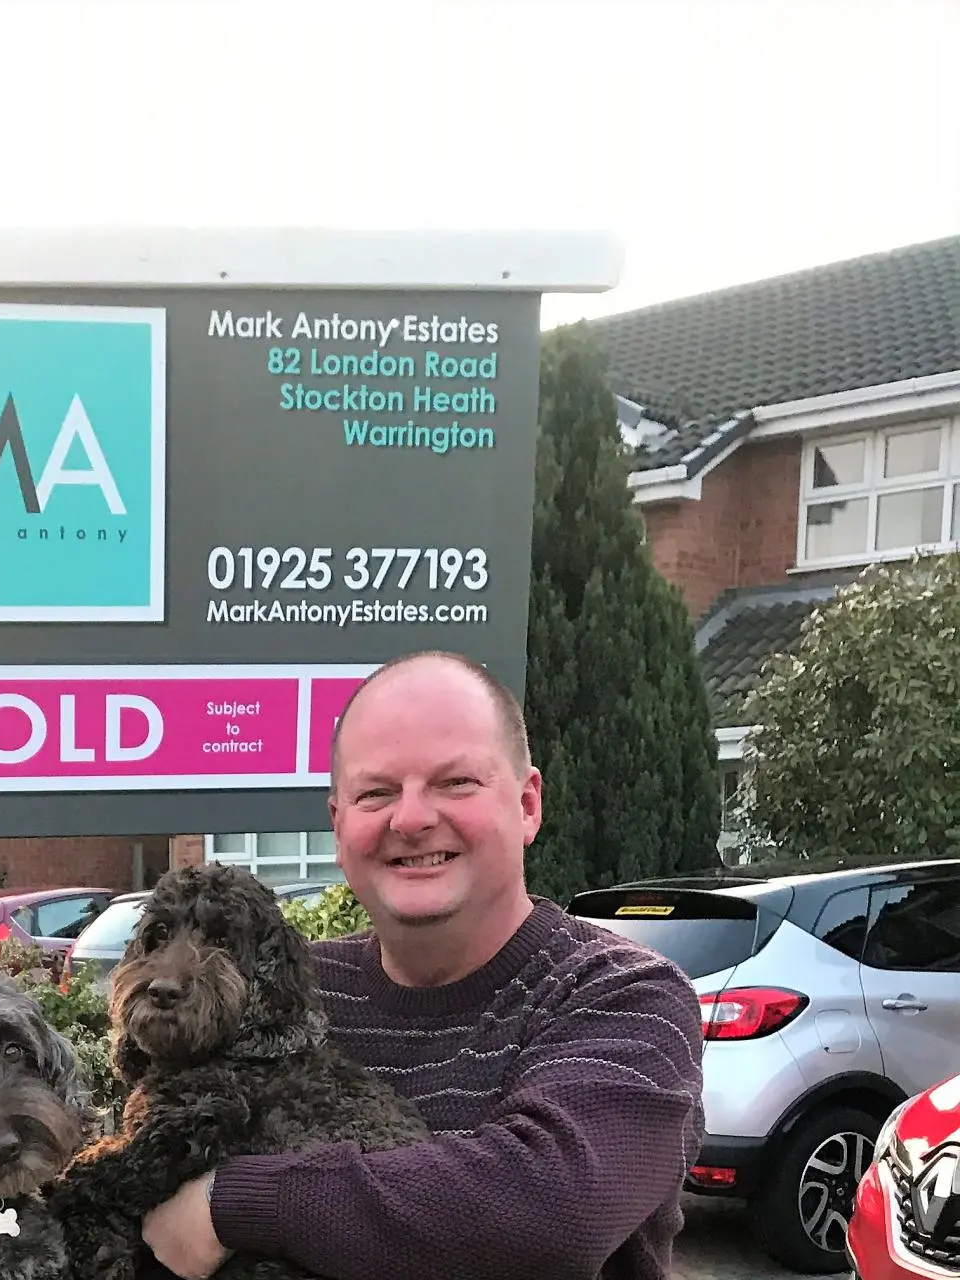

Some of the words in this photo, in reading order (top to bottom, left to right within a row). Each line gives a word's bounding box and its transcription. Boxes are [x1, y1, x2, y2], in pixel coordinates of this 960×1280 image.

[208, 310, 283, 339] Mark
[292, 312, 392, 347] Antony
[403, 315, 498, 343] Estates
[267, 347, 301, 374] 82
[311, 349, 415, 377] London
[425, 351, 497, 378] Road
[280, 383, 404, 411] Stockton
[414, 386, 495, 413] Heath
[343, 420, 494, 453] Warrington
[17, 526, 127, 543] antony
[208, 547, 332, 590] 01925
[344, 547, 488, 590] 377193
[206, 600, 487, 627] MarkAntonyEstates.com
[207, 701, 261, 717] Subject
[225, 722, 240, 735] to
[202, 738, 263, 753] contract
